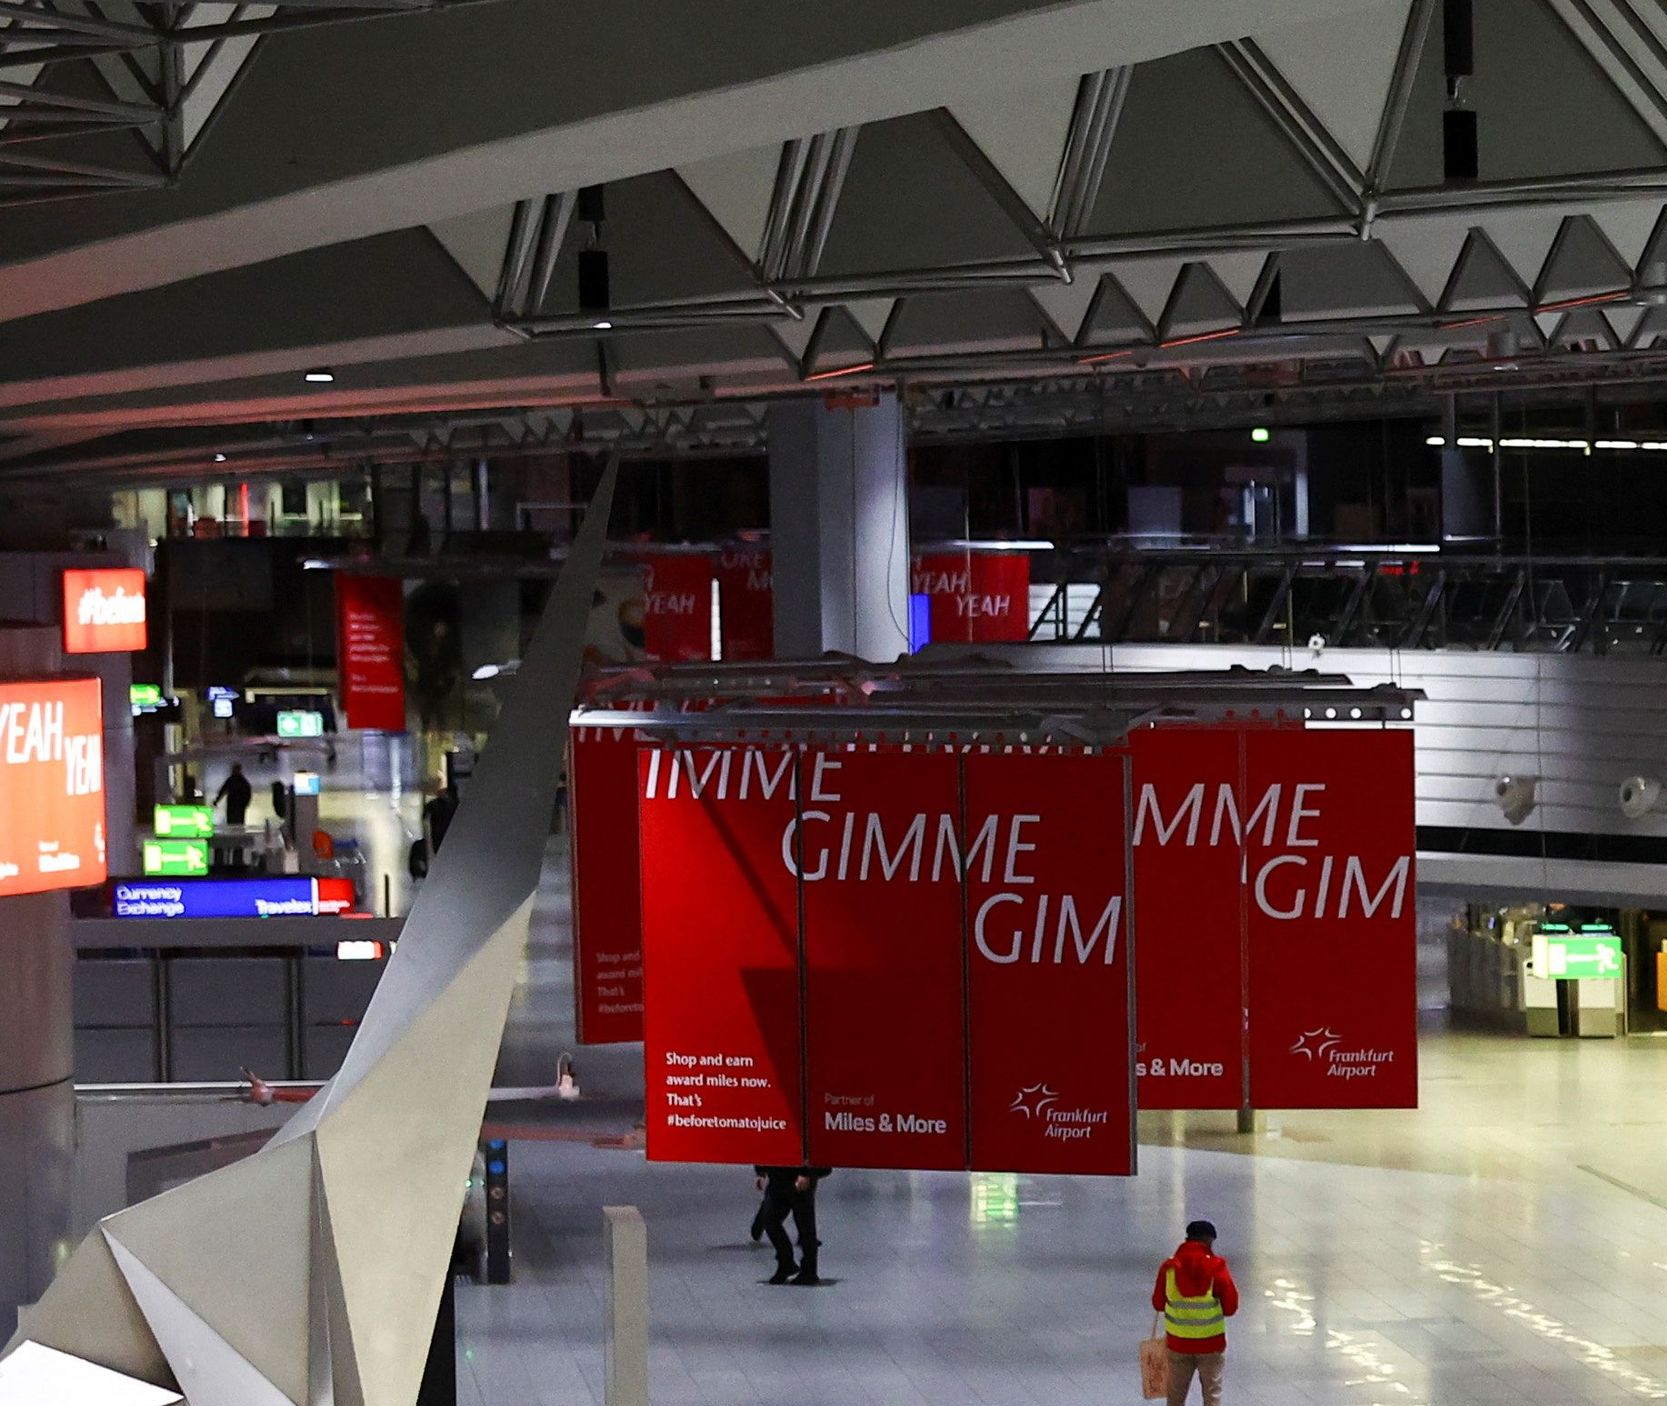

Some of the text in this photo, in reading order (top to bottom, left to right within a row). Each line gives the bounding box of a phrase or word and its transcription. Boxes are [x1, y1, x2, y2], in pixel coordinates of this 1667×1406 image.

[956, 594, 1011, 617] YEAH
[782, 811, 1040, 884] GIMME
[117, 887, 182, 901] Currency
[1255, 855, 1410, 919] GIM
[117, 901, 184, 917] Exchange
[974, 893, 1122, 965] GIM
[666, 1053, 753, 1069] Shop and earn
[1329, 1049, 1394, 1063] Frankfurt
[1150, 1058, 1223, 1076] & More
[1327, 1063, 1376, 1080] Airport
[666, 1074, 771, 1088] award miles now.
[666, 1093, 702, 1107] That's
[667, 1115, 786, 1132] #beforetomatojuice
[825, 1112, 946, 1133] Miles & More
[1046, 1108, 1107, 1123] Frankfurt
[1045, 1124, 1091, 1142] Airport
